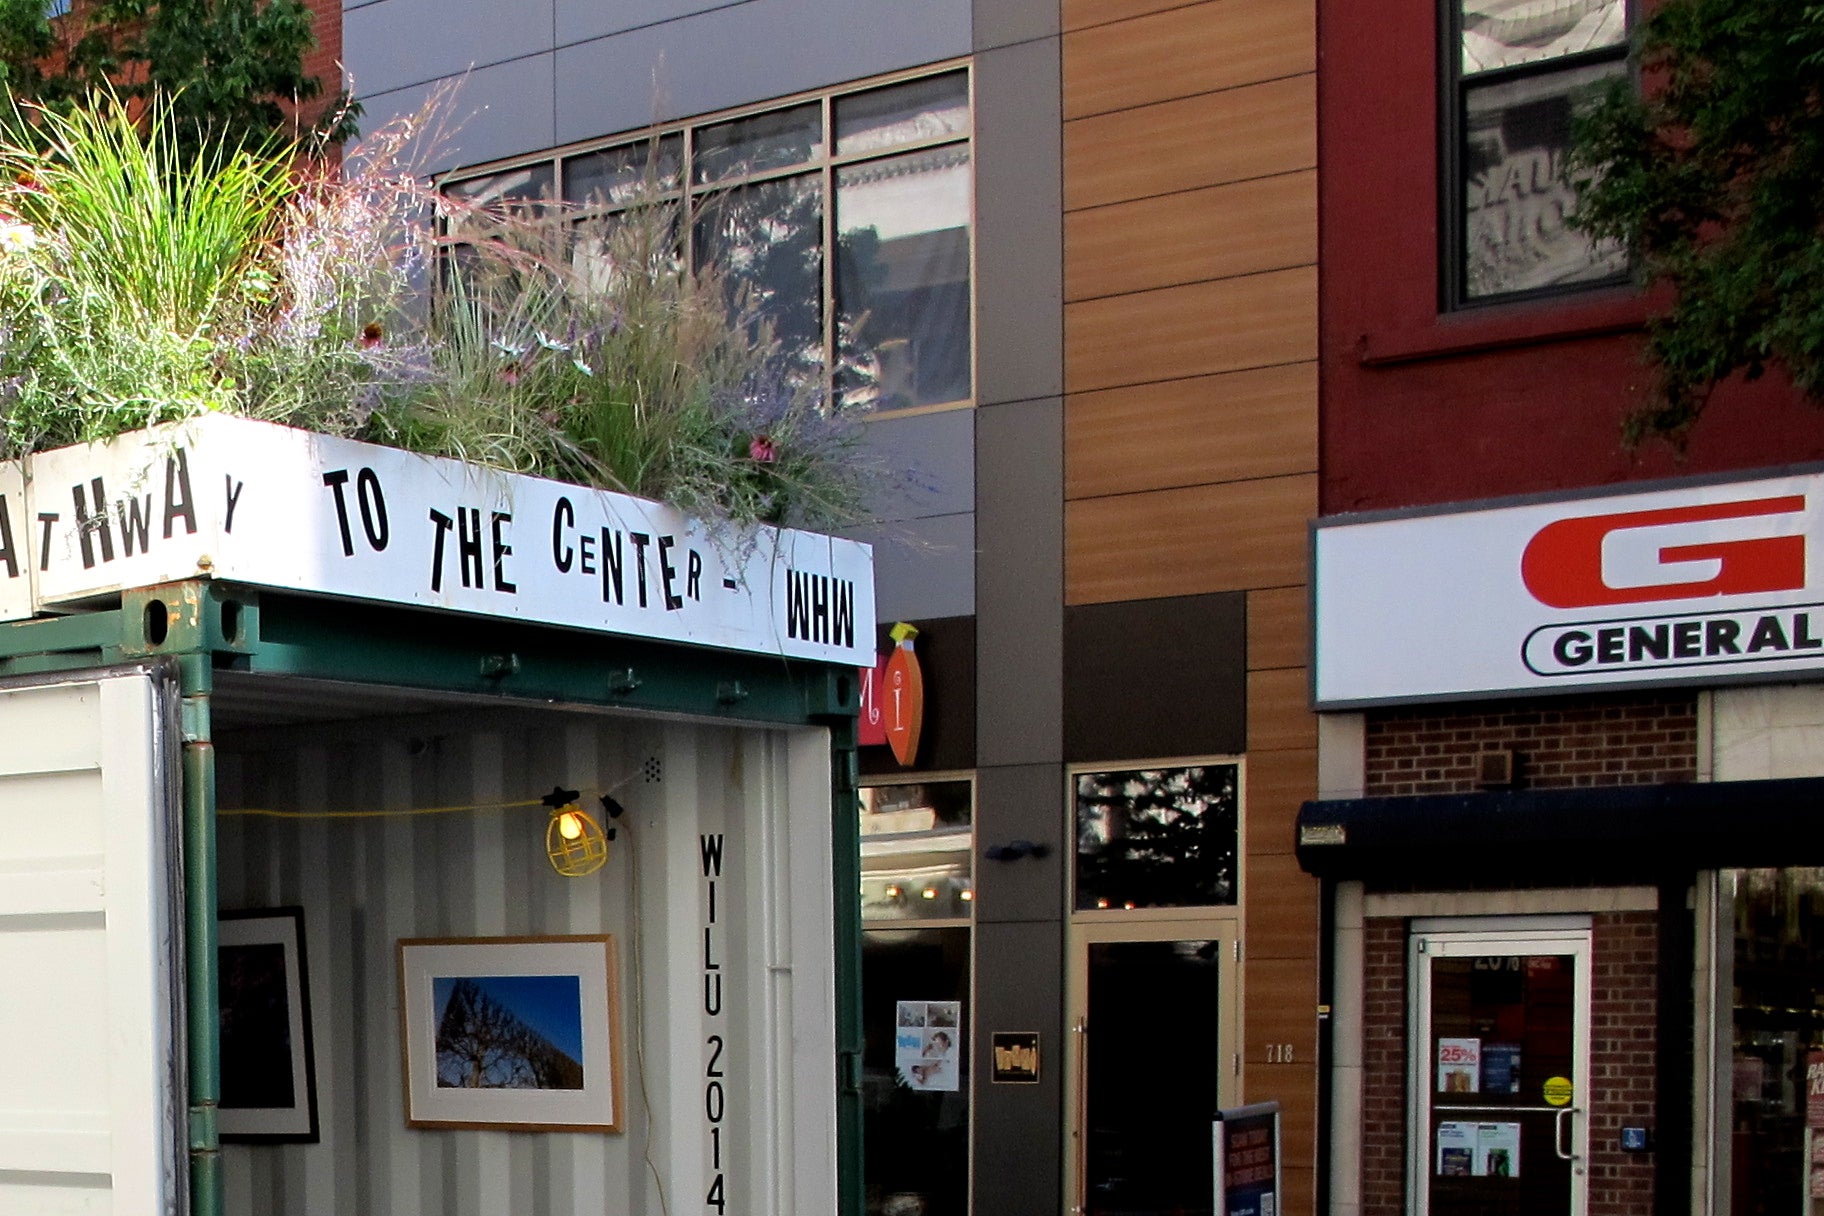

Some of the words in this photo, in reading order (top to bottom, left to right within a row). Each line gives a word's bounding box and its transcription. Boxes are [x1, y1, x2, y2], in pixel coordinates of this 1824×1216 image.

[322, 466, 390, 557] TO
[428, 505, 517, 595] THE
[552, 496, 703, 612] CENTER
[786, 569, 855, 649] WHW
[1521, 494, 1806, 610] G
[1552, 612, 1823, 668] GENERAL
[699, 833, 725, 1018] WILU
[1266, 1044, 1293, 1063] 718
[1440, 1048, 1478, 1062] 25%
